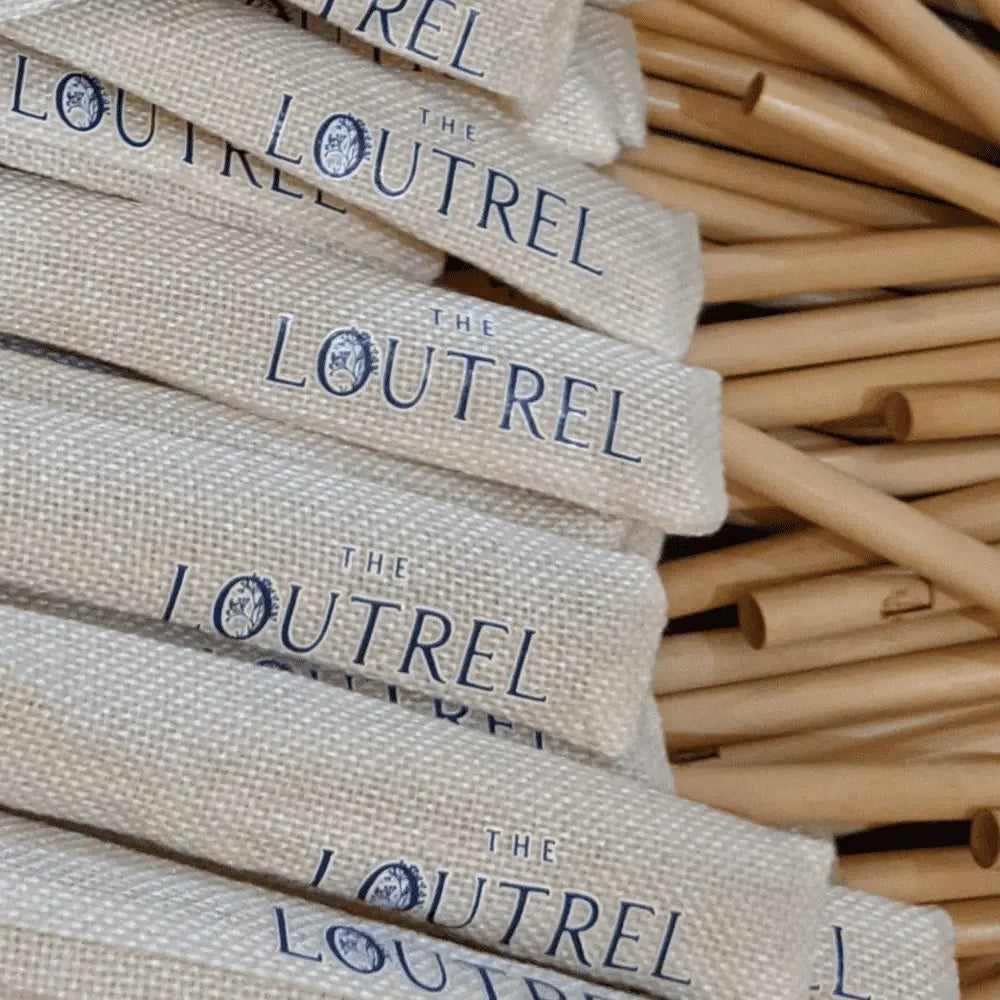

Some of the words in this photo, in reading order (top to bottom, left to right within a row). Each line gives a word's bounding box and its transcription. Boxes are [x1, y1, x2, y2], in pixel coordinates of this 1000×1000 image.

[420, 108, 478, 143] THE
[266, 94, 604, 276] LOUTREL
[431, 308, 495, 337] THE
[265, 316, 643, 465] LOUTREL
[342, 547, 409, 579] THE
[486, 829, 557, 863] THE
